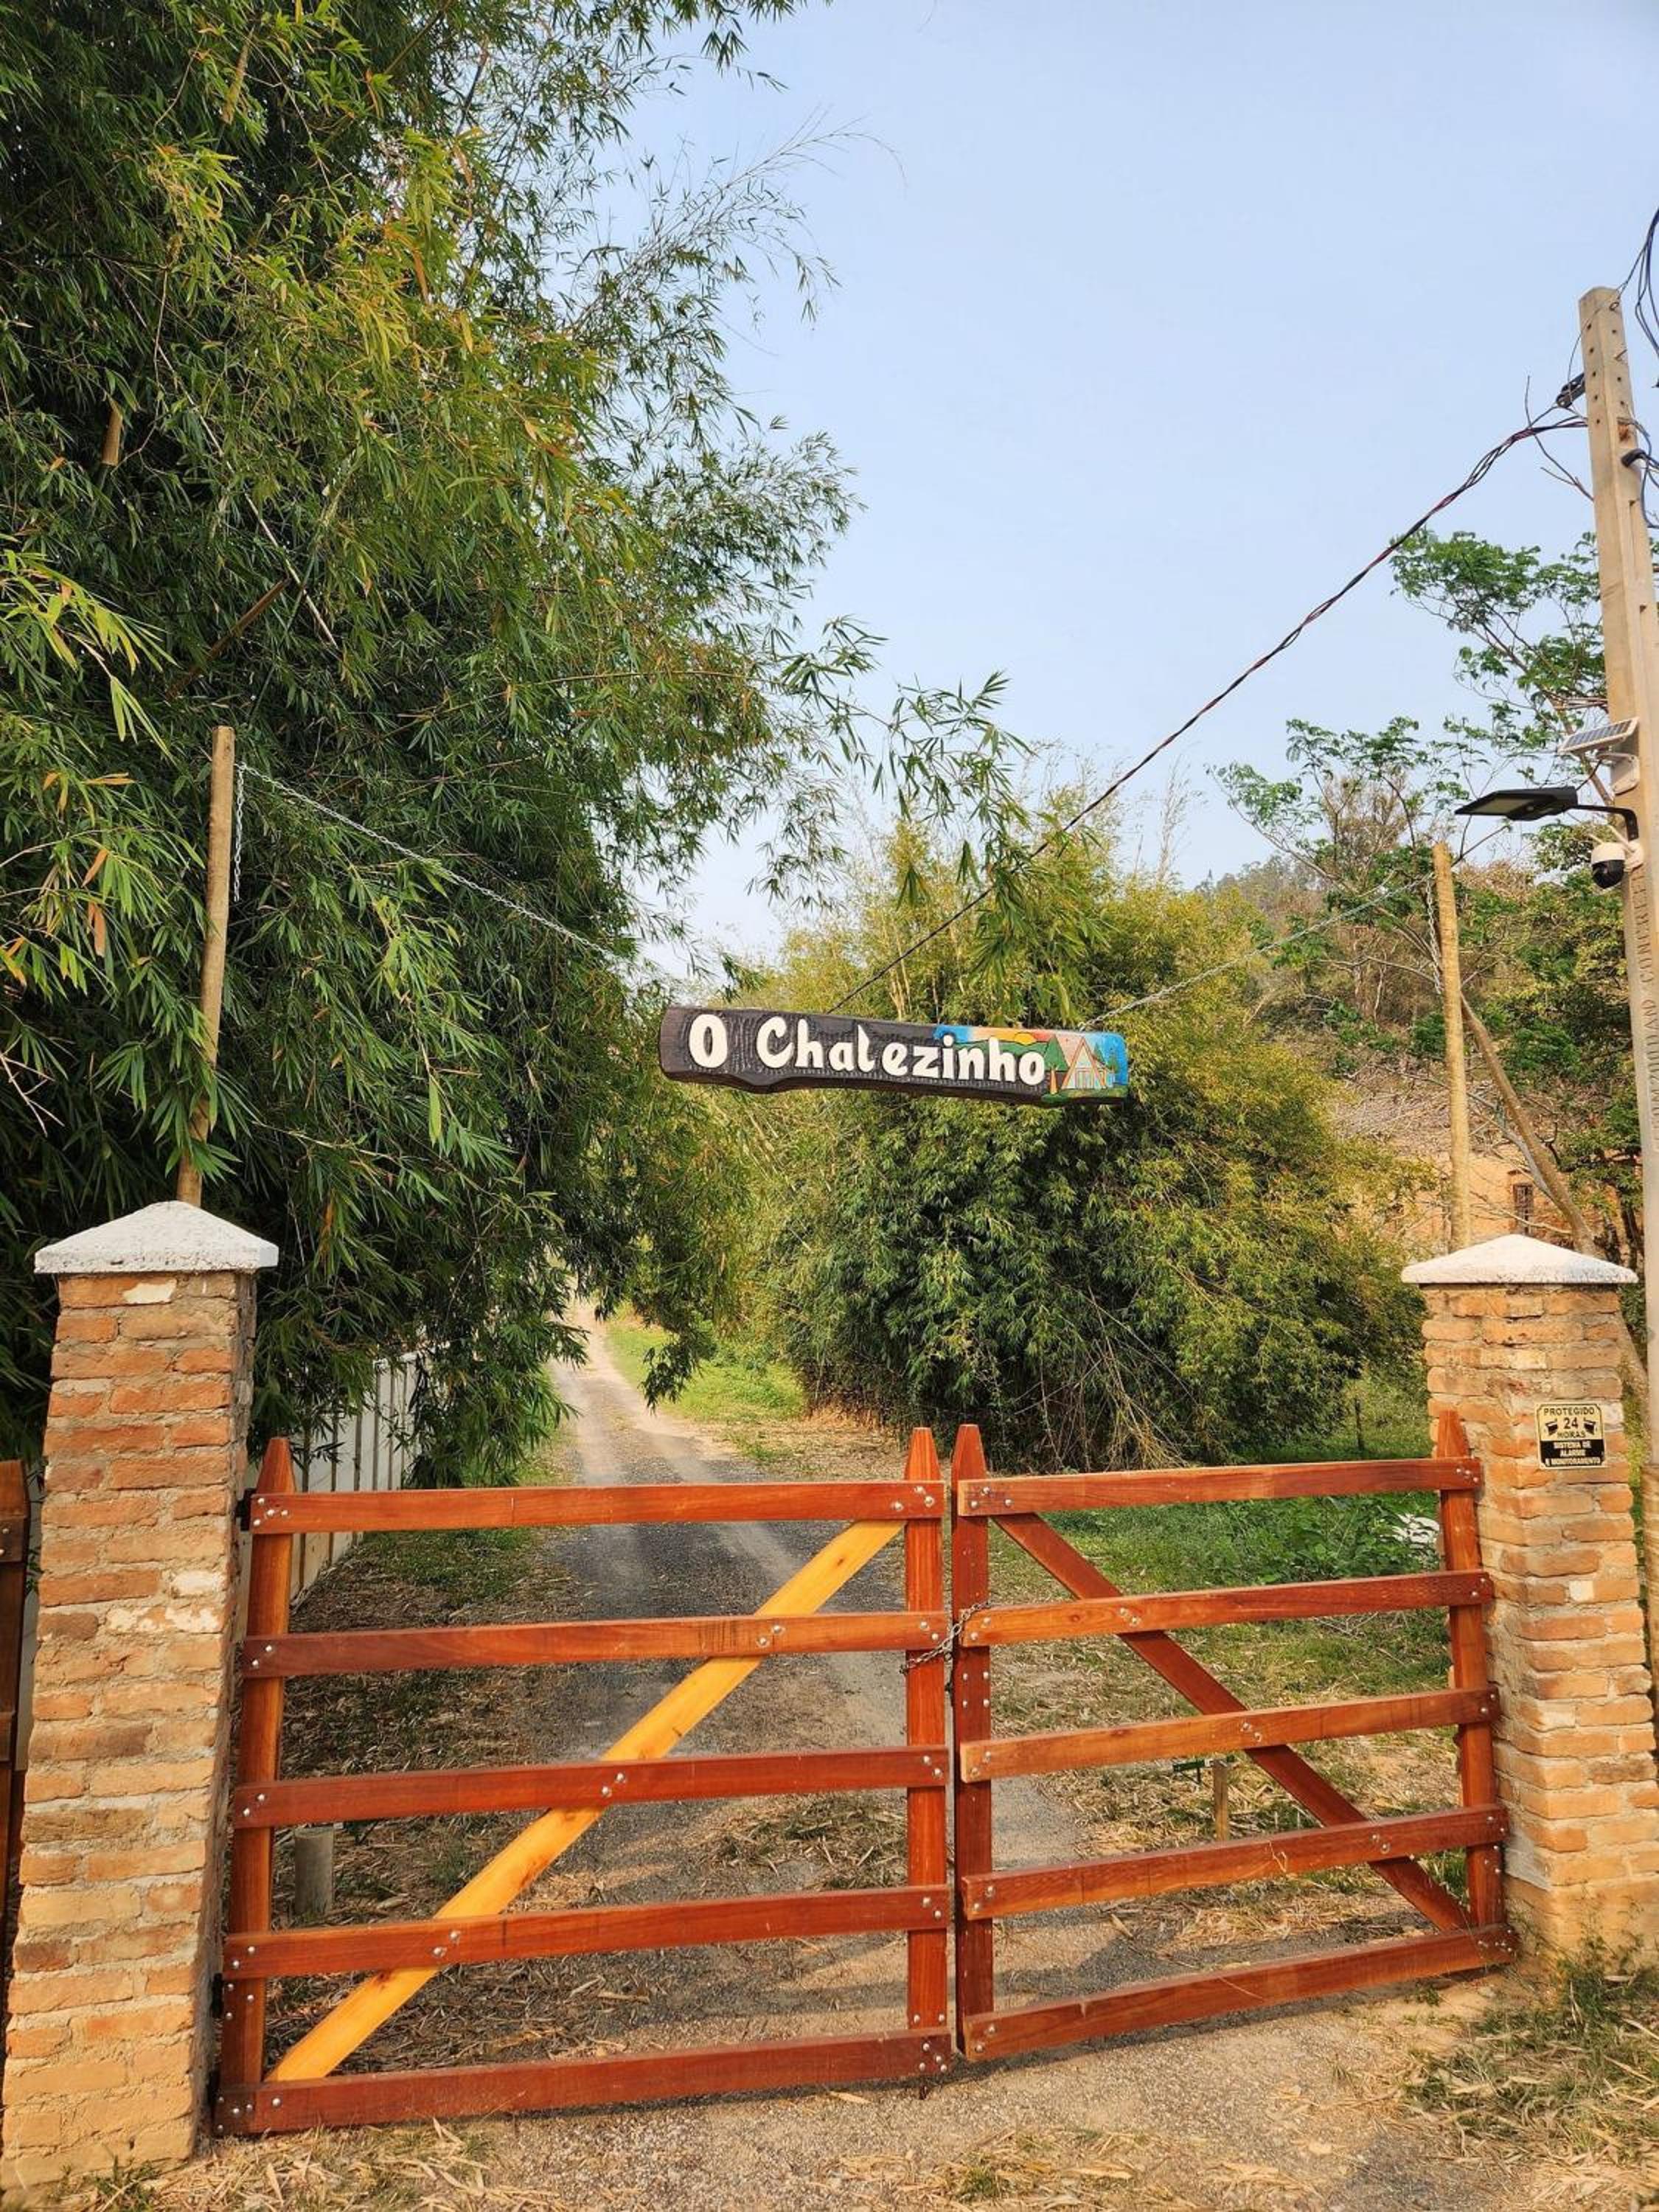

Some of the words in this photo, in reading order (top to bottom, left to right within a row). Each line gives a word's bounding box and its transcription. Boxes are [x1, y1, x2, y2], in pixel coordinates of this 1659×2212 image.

[689, 1014, 728, 1068] O
[756, 1015, 1046, 1085] Chalezinho
[1544, 1406, 1595, 1416] PROTEGIDO
[1563, 1417, 1579, 1429] 24
